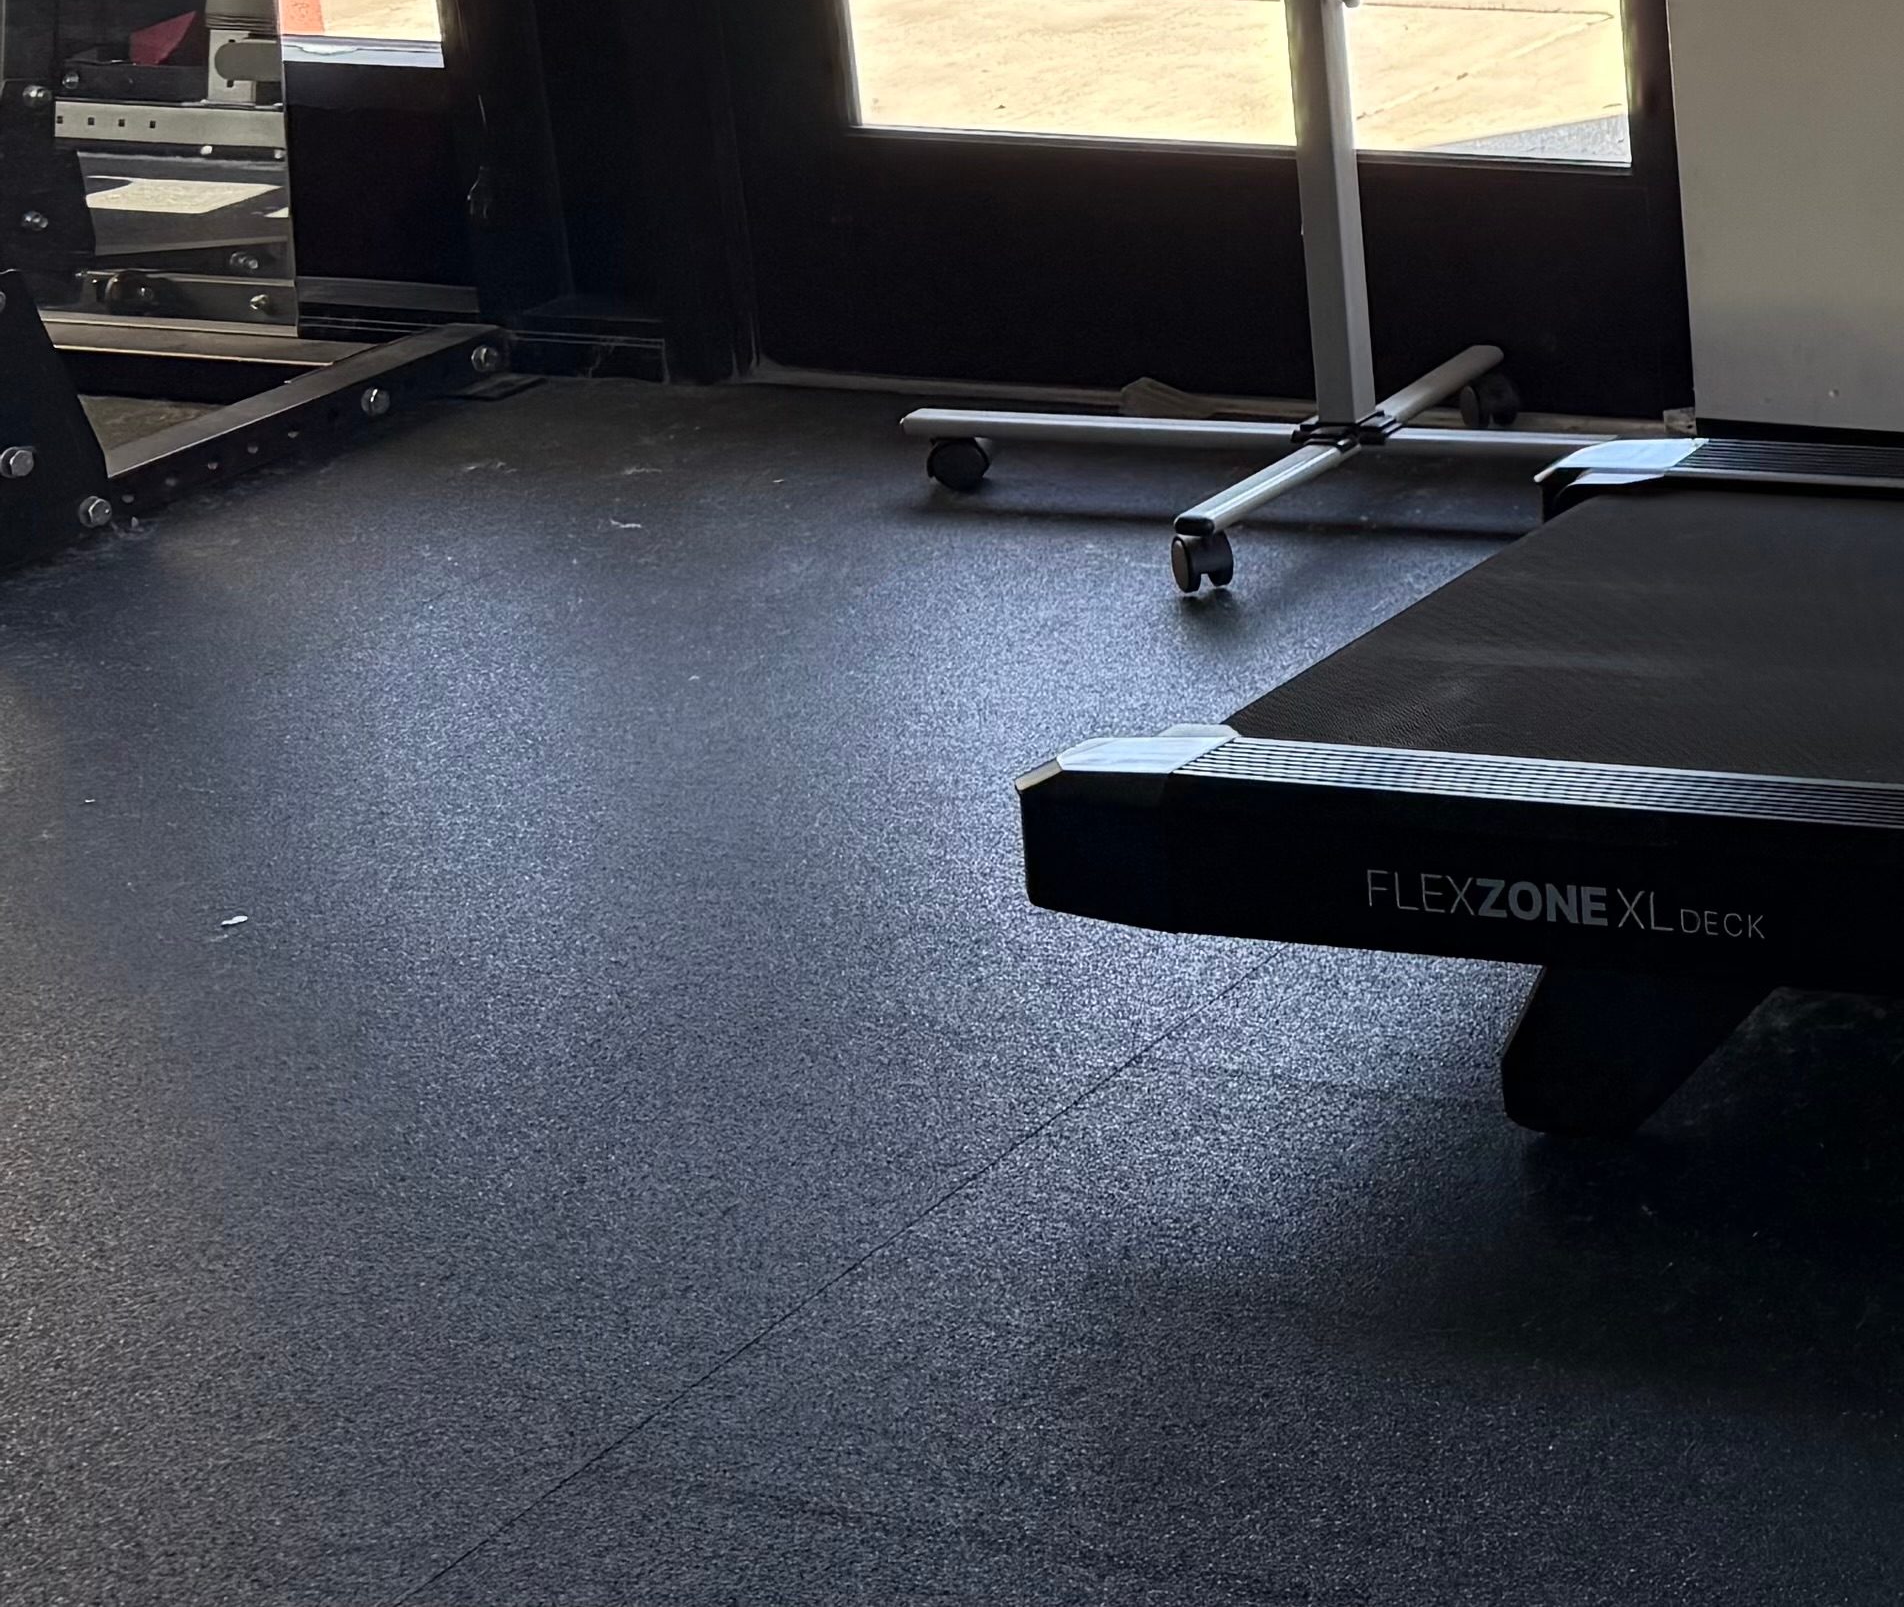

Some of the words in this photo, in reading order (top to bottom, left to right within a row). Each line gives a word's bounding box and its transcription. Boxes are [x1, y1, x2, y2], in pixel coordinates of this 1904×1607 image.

[1366, 870, 1608, 928] FLEXZONE
[1615, 886, 1675, 935] XL
[1679, 906, 1767, 940] DECK
